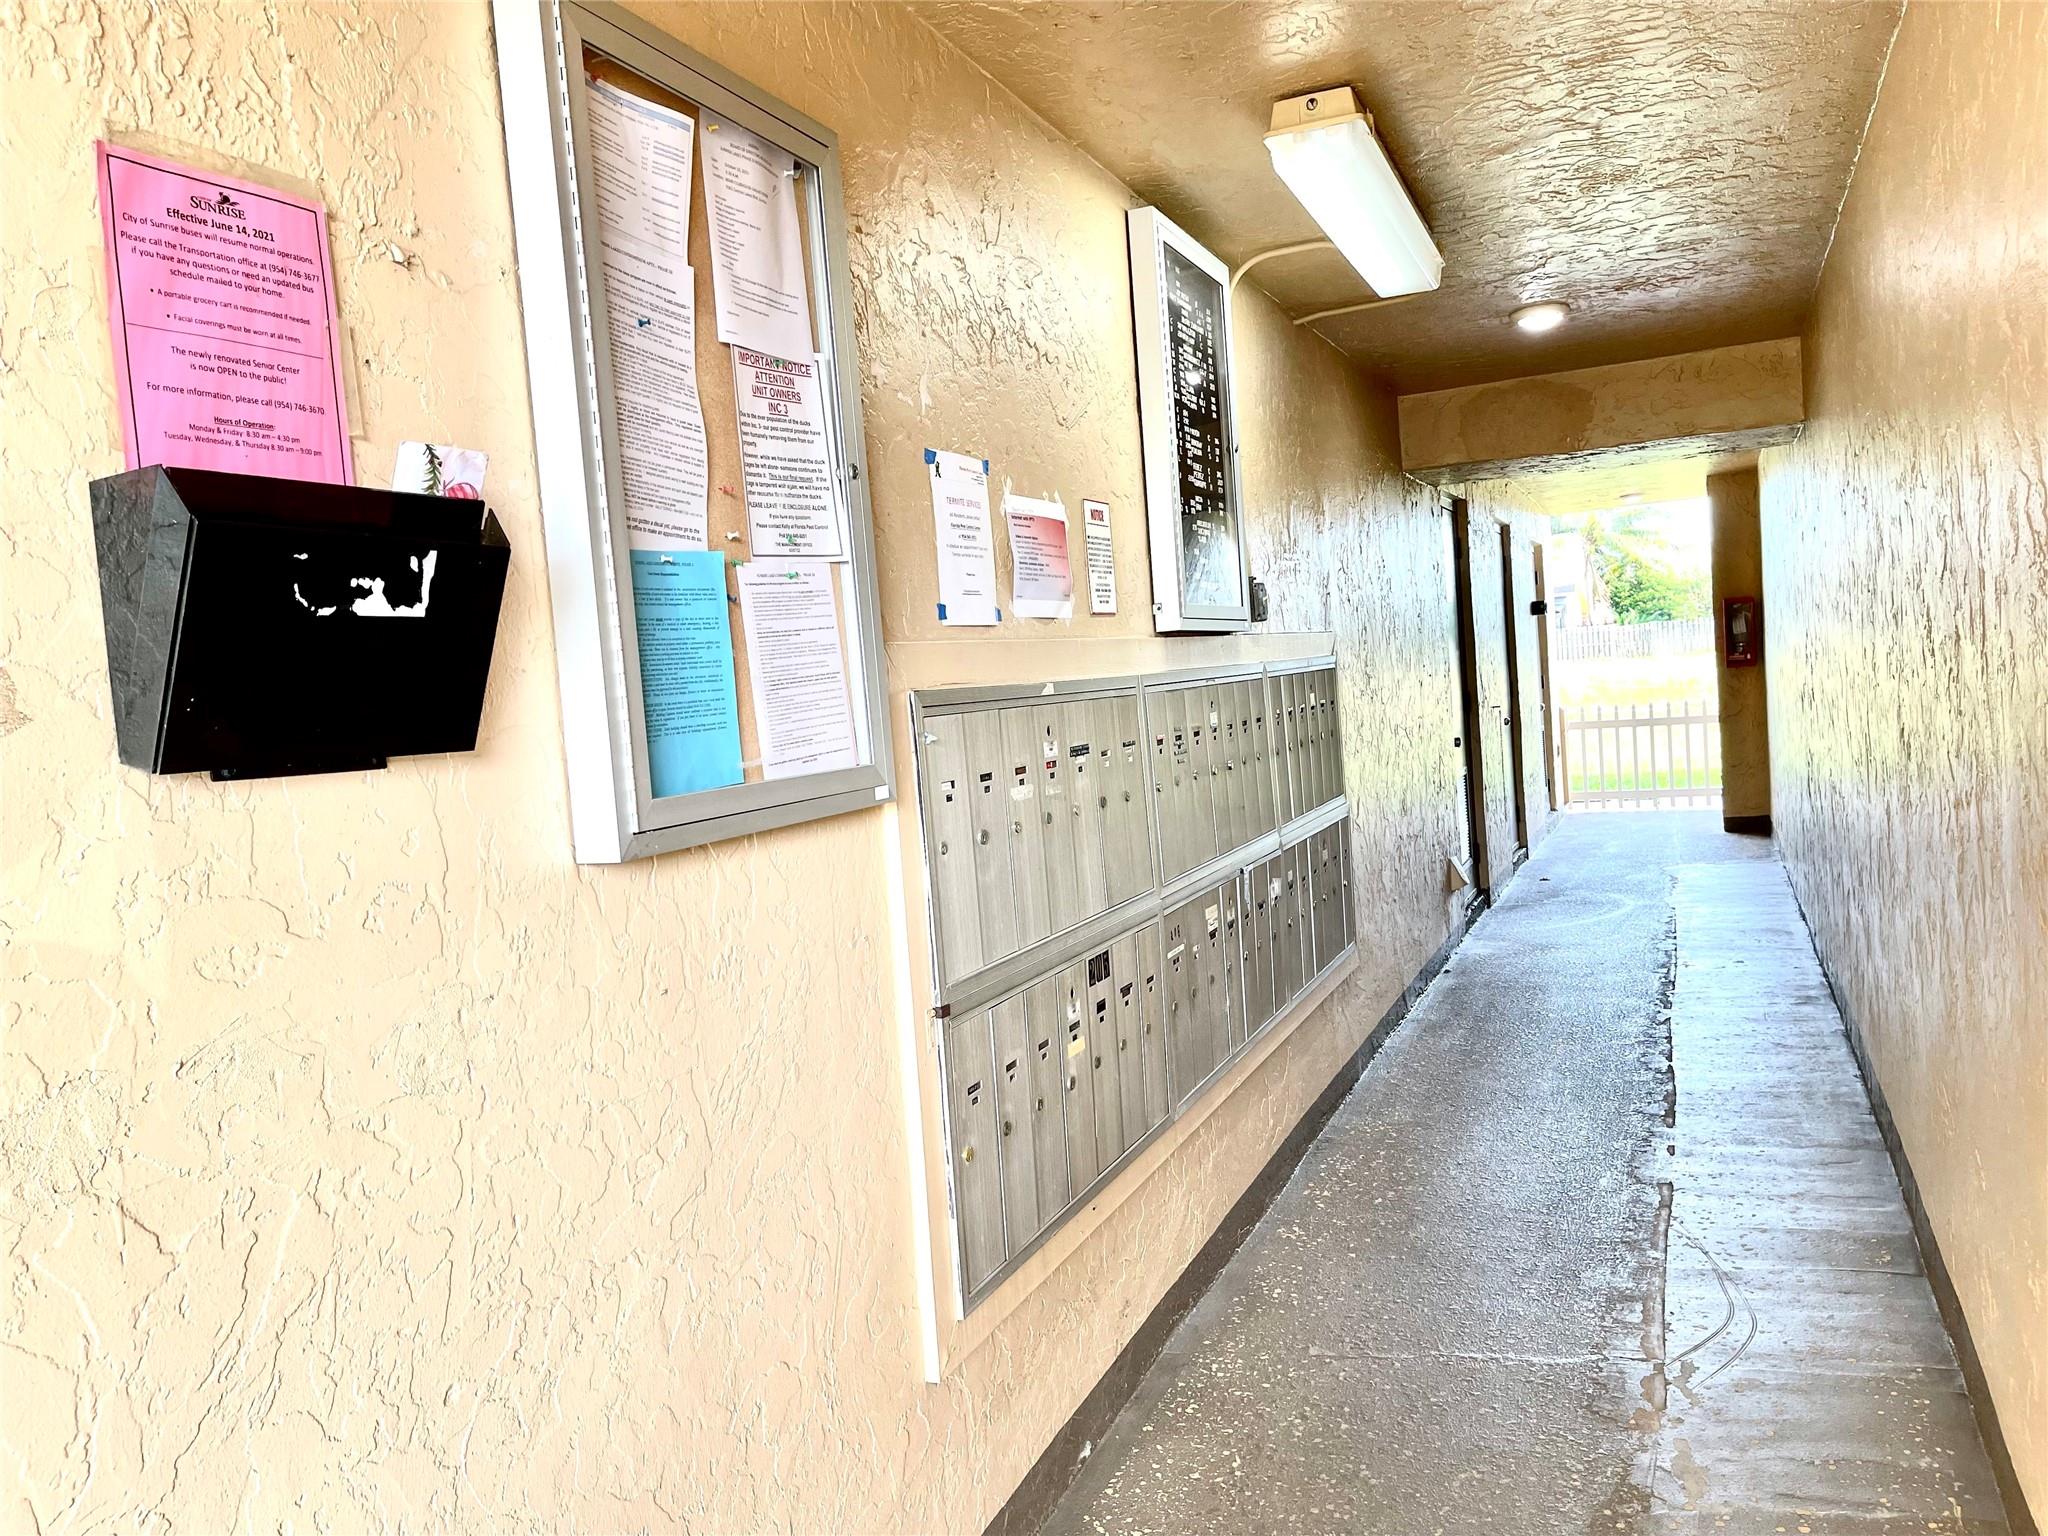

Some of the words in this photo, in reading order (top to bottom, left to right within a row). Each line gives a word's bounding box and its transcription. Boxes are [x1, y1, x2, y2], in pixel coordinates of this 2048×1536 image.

[190, 196, 246, 220] SUNRISE
[123, 212, 137, 224] City
[150, 219, 178, 232] Sunrise
[181, 226, 202, 238] buses
[205, 233, 217, 241] will
[220, 236, 247, 248] resume
[250, 243, 275, 255] normal
[167, 208, 208, 226] Effective
[211, 219, 233, 232] June
[236, 224, 250, 237] 14,
[253, 229, 274, 242] 2021
[121, 231, 146, 243] Please
[149, 238, 162, 246] call
[164, 241, 177, 250] the
[179, 244, 235, 262] Transportation
[238, 257, 258, 268] office
[269, 264, 287, 276] (954)
[289, 268, 319, 282] 746-3677
[139, 249, 154, 257] you
[156, 252, 174, 262] have
[177, 257, 190, 267] any
[192, 261, 229, 274] questions
[242, 272, 260, 280] need
[272, 279, 300, 290] updated
[302, 284, 314, 293] bus
[170, 269, 204, 281] schedule
[207, 276, 232, 287] mailed
[234, 281, 242, 289] to
[164, 291, 191, 300] portable
[194, 297, 218, 306] grocery
[240, 305, 283, 319] recommended
[174, 314, 193, 322] Facial
[195, 318, 225, 329] coverings
[227, 324, 241, 332] must
[171, 346, 186, 355] The
[189, 350, 211, 361] newly
[214, 354, 251, 366] renovated
[253, 360, 275, 370] Senior
[277, 364, 300, 374] Center
[783, 361, 811, 375] NOTICE
[217, 366, 237, 376] OPEN
[240, 370, 247, 378] to
[250, 372, 261, 380] the
[264, 375, 286, 384] public!
[755, 371, 795, 386] ATTENTION
[147, 382, 160, 390] For
[163, 385, 184, 394] more
[187, 388, 233, 402] information,
[236, 395, 259, 404] please
[275, 400, 292, 411] (954)
[294, 403, 325, 415] 746-3670
[752, 385, 767, 395] UNIT
[770, 387, 801, 401] OWNERS
[768, 402, 781, 413] INC
[784, 404, 788, 414] 3
[189, 424, 215, 434] Monday
[223, 428, 243, 437] Friday
[214, 416, 233, 425] Hours
[243, 420, 276, 429] Operation:
[242, 440, 270, 451] Thursday
[1088, 949, 1110, 987] 205
